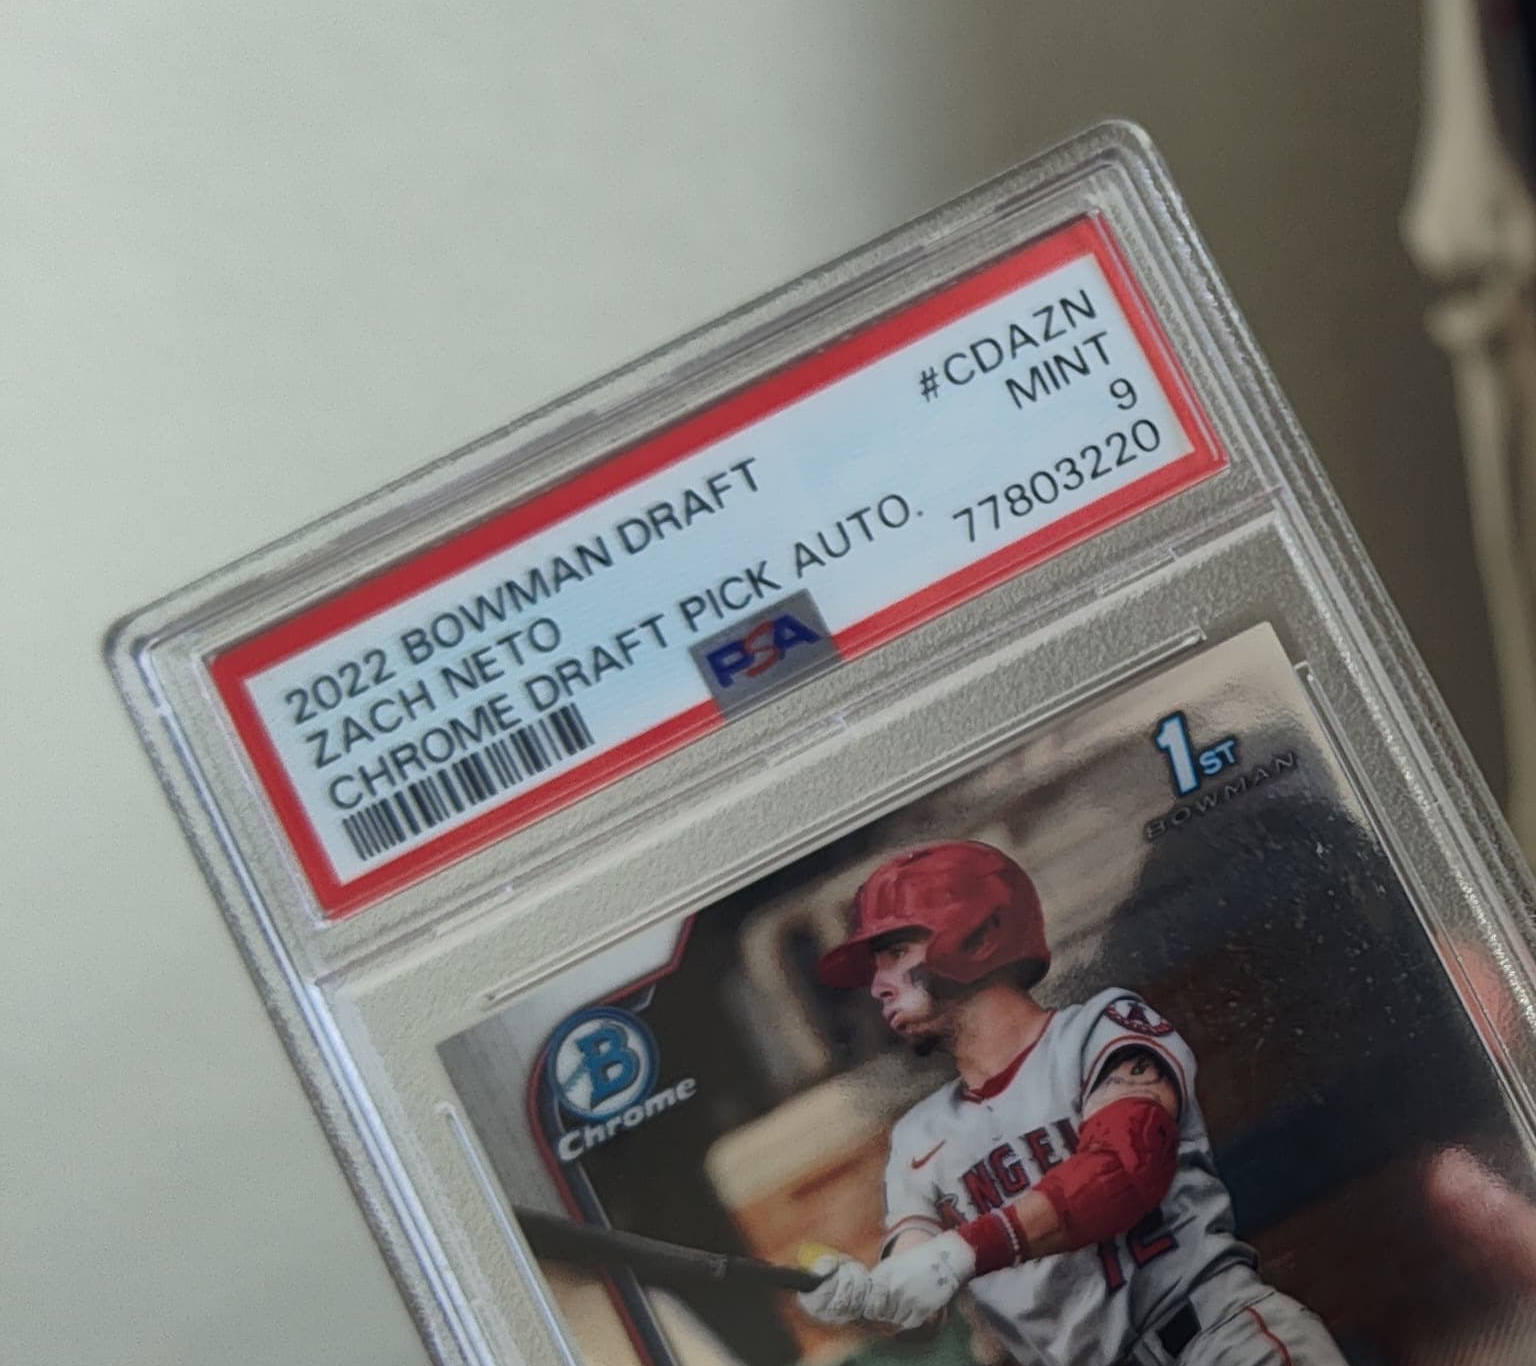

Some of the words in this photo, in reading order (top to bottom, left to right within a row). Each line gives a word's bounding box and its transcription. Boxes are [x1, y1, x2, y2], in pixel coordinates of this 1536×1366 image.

[918, 289, 1098, 403] #CDAZN
[1005, 331, 1113, 409] MINT
[1108, 377, 1138, 411] 9
[952, 418, 1161, 543] 77803220
[284, 648, 396, 726] 2022
[401, 535, 614, 666] BOWMAN
[616, 457, 760, 555] DRAFT
[305, 678, 436, 769] ZACH
[441, 615, 561, 700] NETO
[328, 692, 523, 811] CHROME
[526, 613, 671, 714] DRAFT
[678, 560, 783, 633] PICK
[792, 493, 924, 580] AUTO.
[705, 613, 821, 690] PSA
[1144, 750, 1300, 840] BOWMAN
[557, 1077, 698, 1162] Chrome
